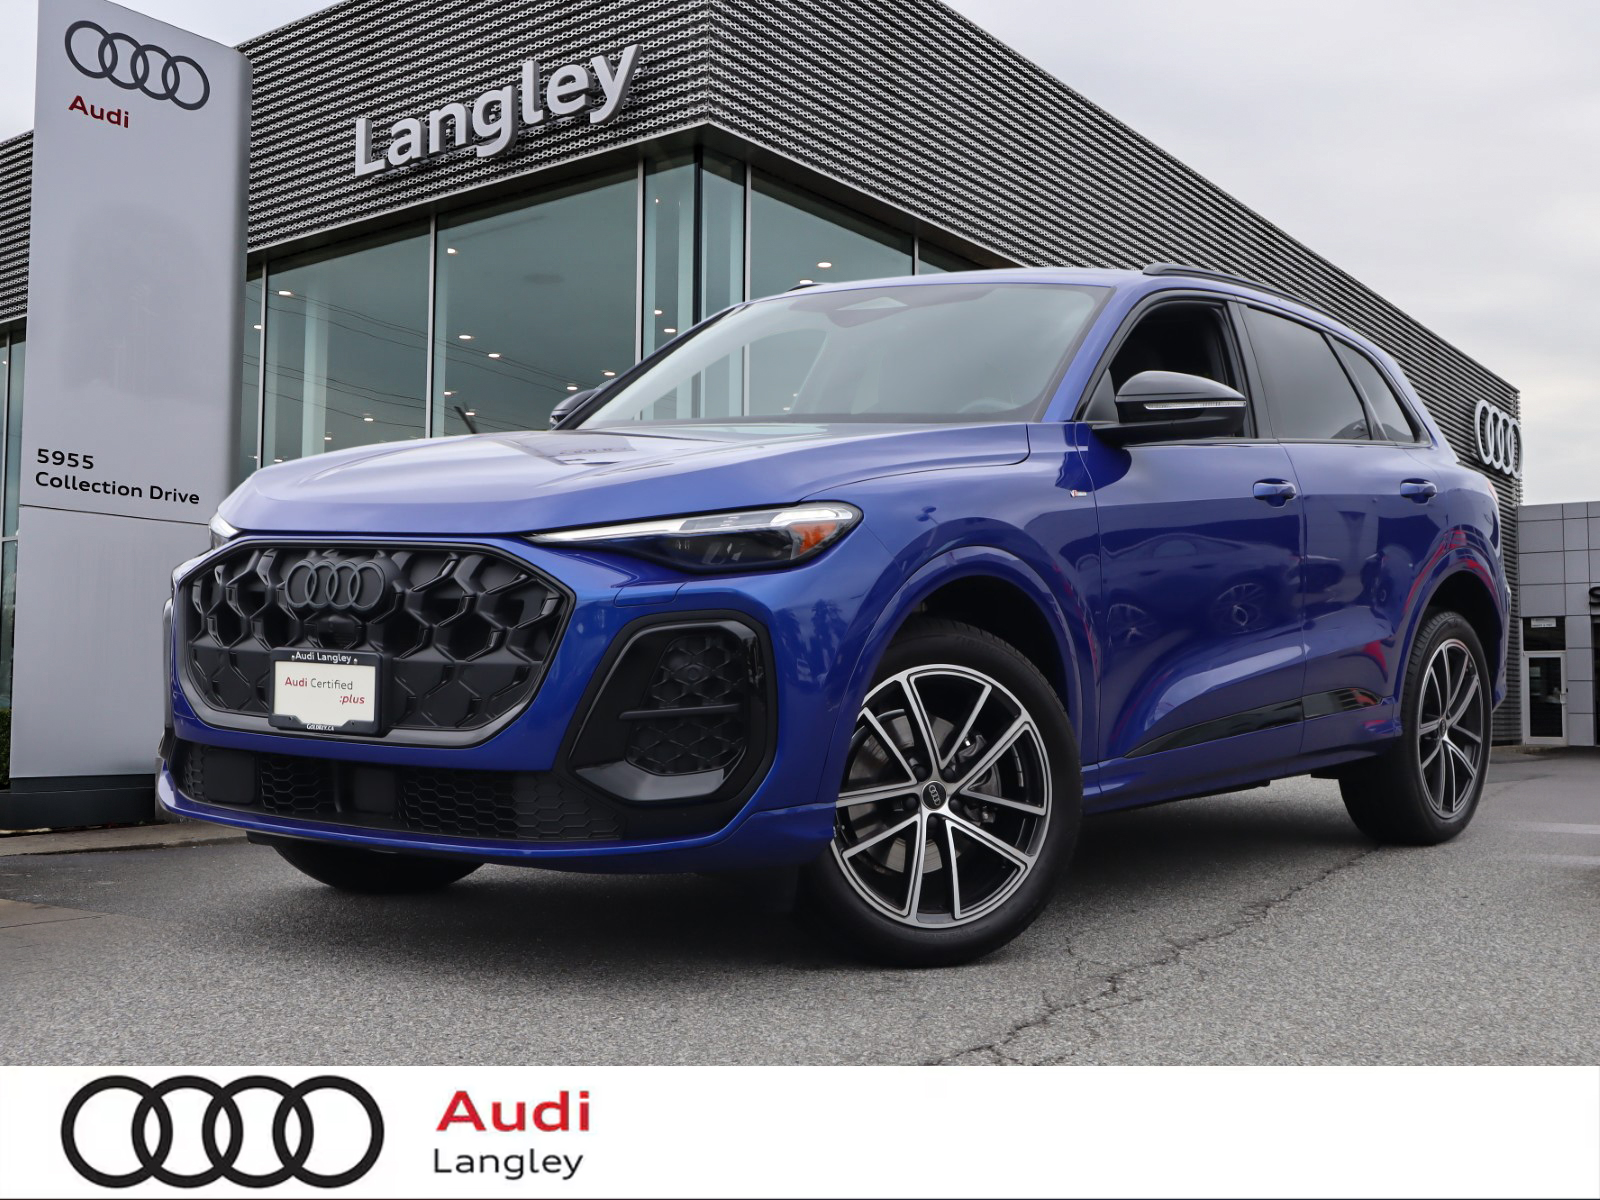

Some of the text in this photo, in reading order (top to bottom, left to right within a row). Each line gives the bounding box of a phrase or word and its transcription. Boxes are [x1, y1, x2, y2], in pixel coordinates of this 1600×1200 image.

[68, 95, 129, 128] Audi
[355, 44, 643, 176] Langley
[37, 448, 94, 469] 5955
[35, 472, 200, 504] Collection Drive
[295, 651, 352, 664] Audi Langley
[284, 676, 354, 690] Audi Certified
